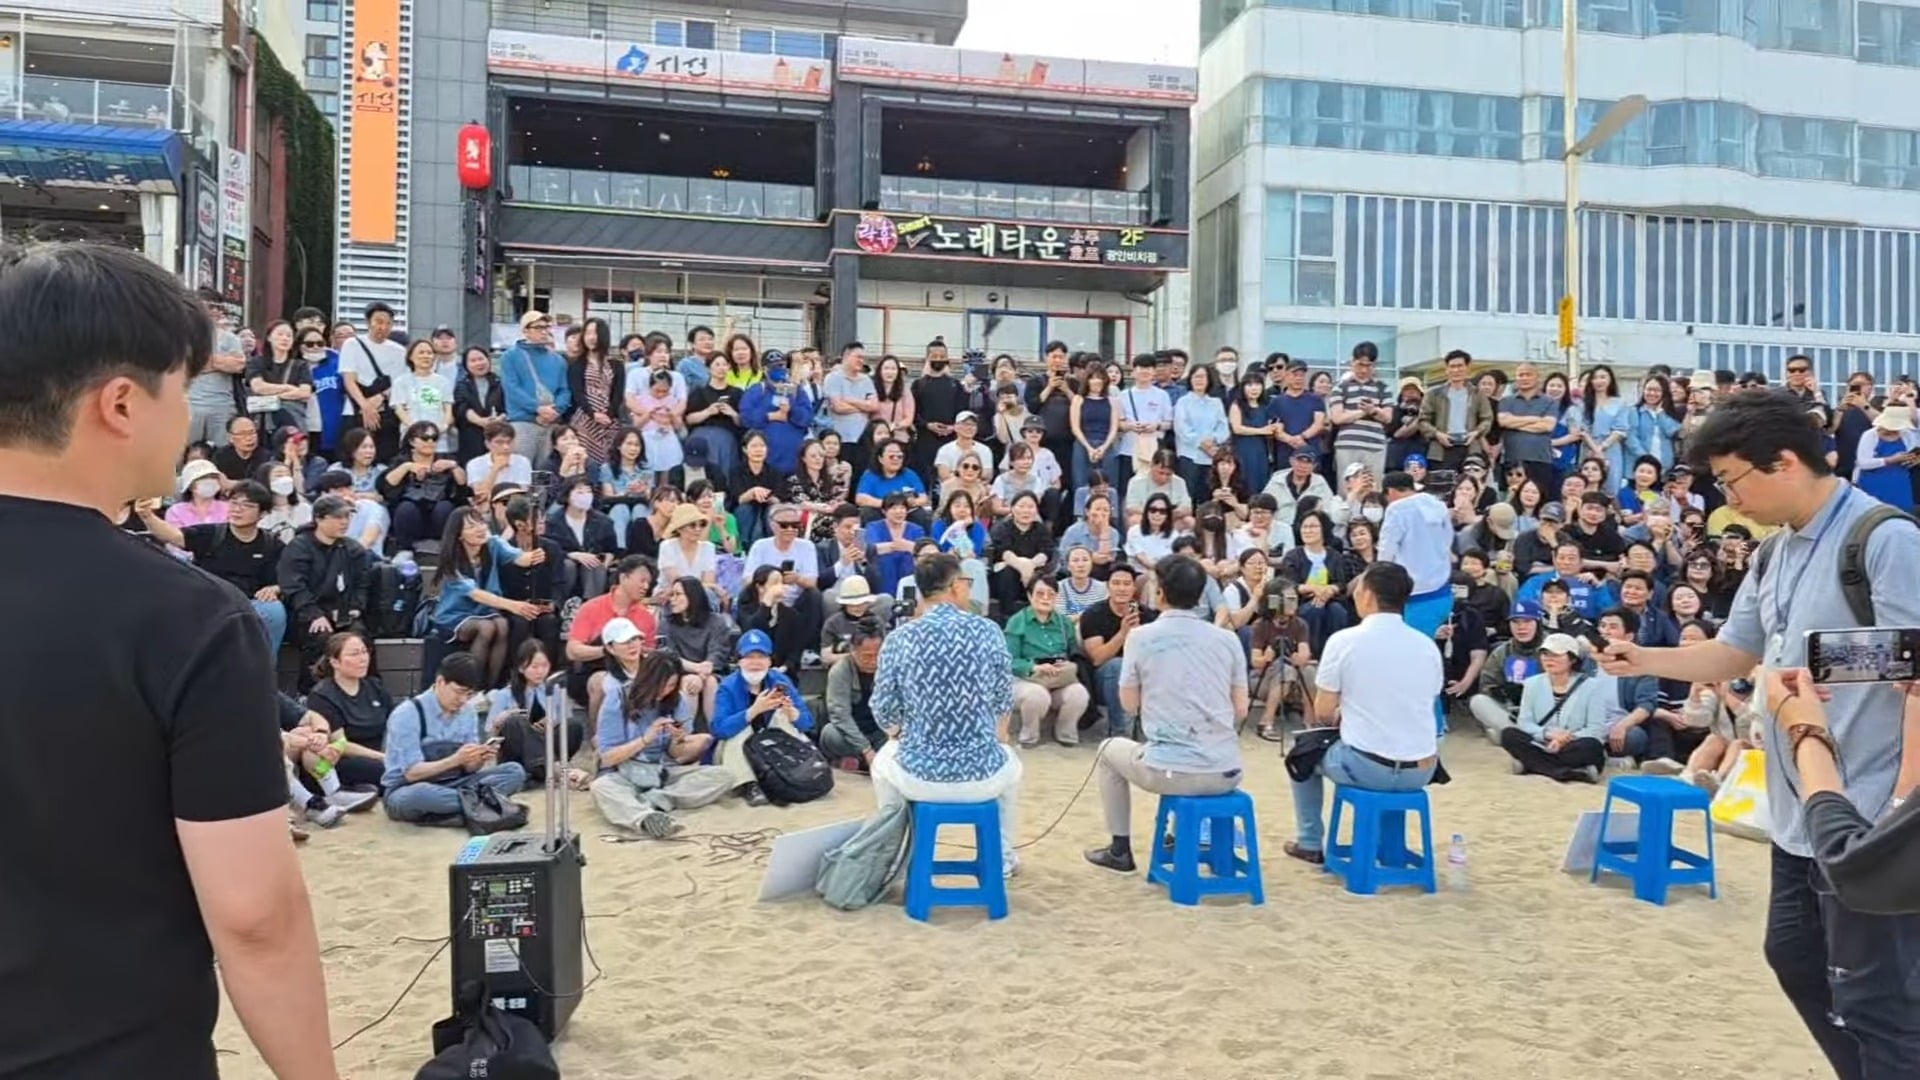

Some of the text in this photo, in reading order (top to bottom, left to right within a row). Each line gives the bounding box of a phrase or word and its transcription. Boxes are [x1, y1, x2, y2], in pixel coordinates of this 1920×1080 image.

[930, 223, 1067, 260] 노래타운
[1119, 228, 1144, 246] 2F
[1105, 249, 1158, 264] 광안비치점
